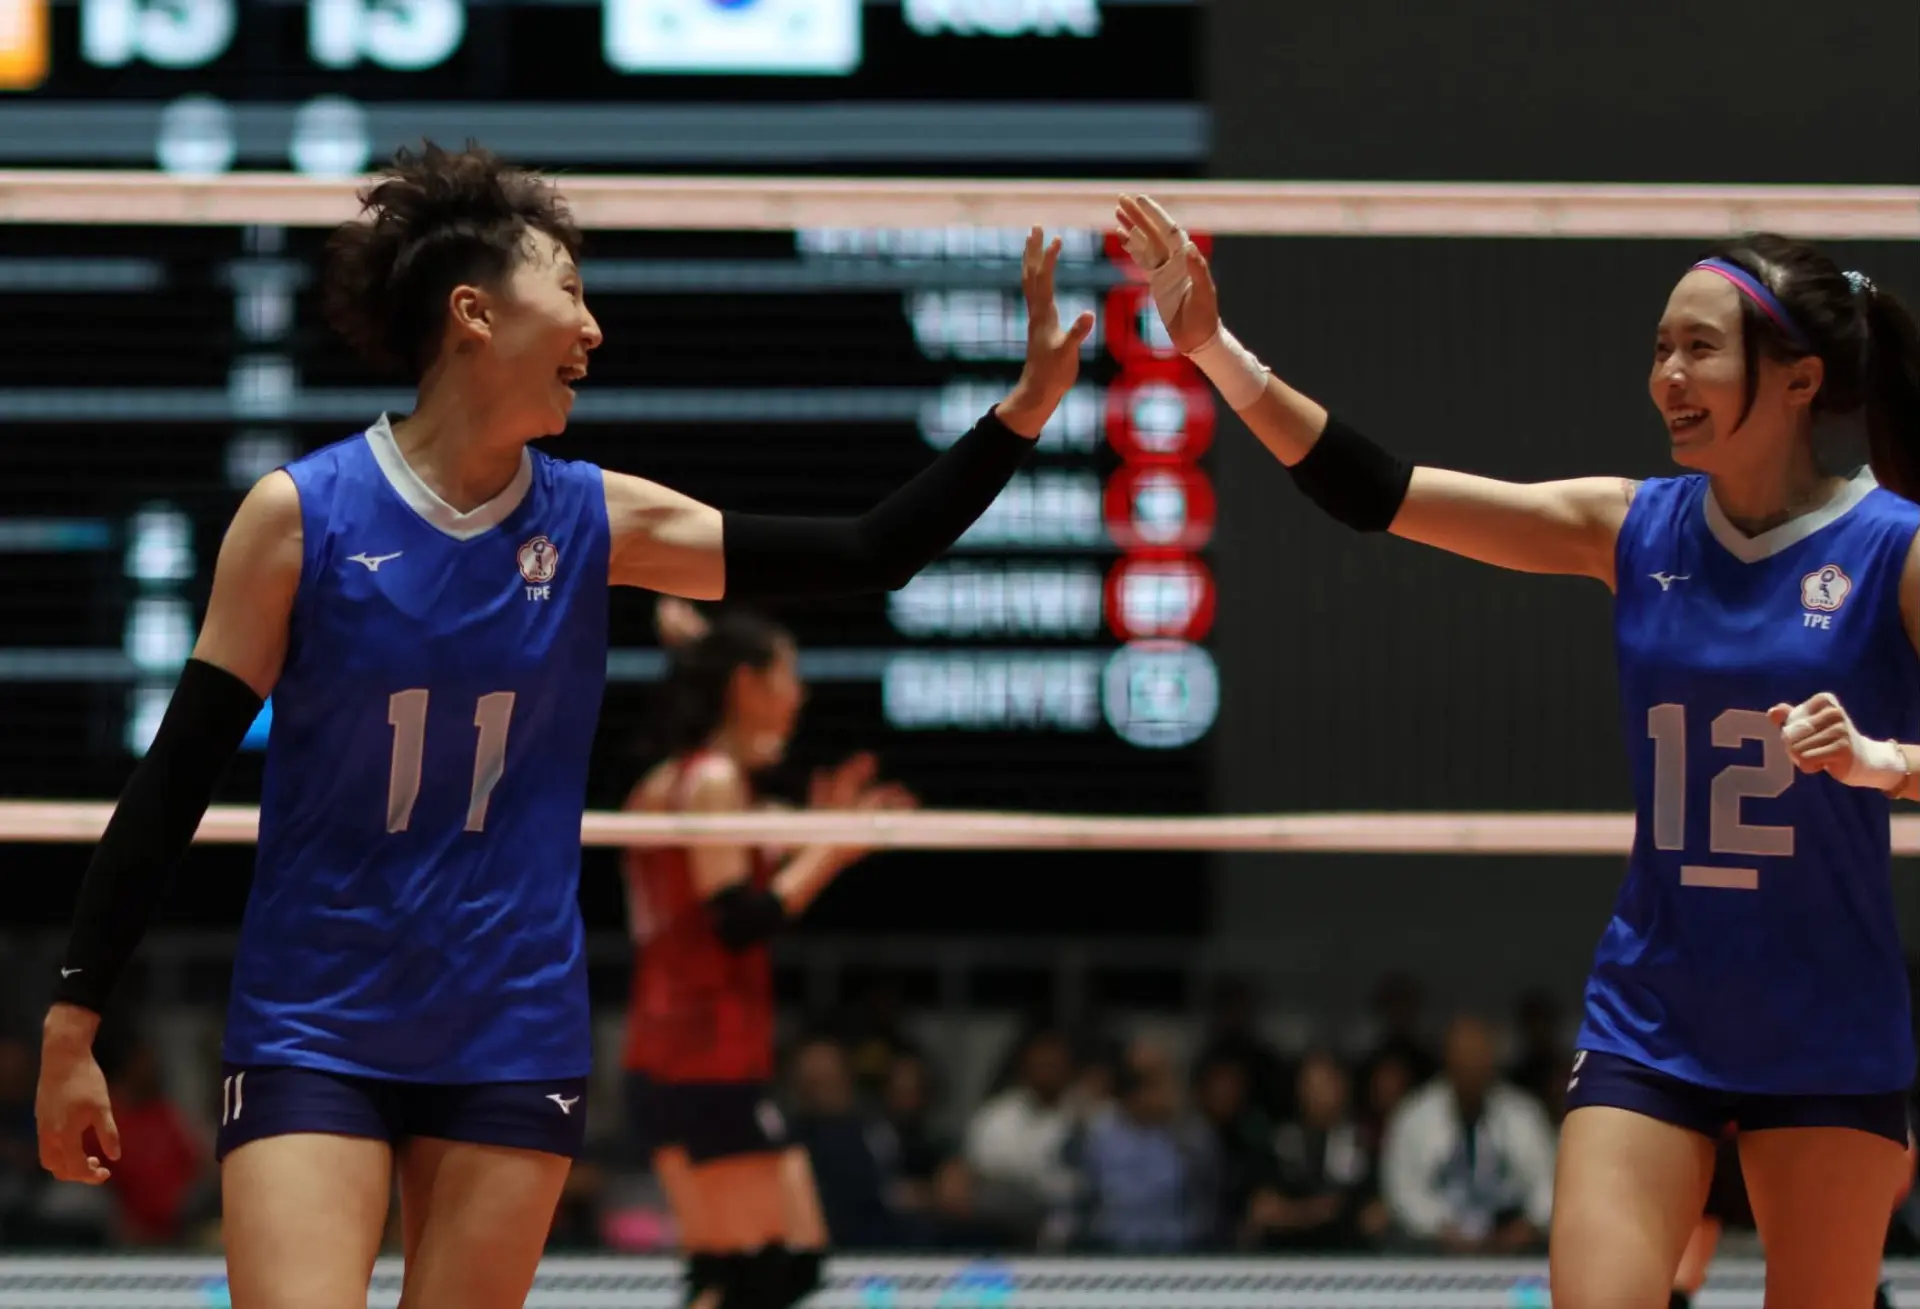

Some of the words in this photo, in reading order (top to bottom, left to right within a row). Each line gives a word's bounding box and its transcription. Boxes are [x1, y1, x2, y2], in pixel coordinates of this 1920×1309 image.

[525, 585, 551, 601] TPE
[1803, 612, 1832, 630] TPE
[386, 688, 516, 834] 11
[1647, 703, 1795, 857] 12
[222, 1070, 246, 1127] 11
